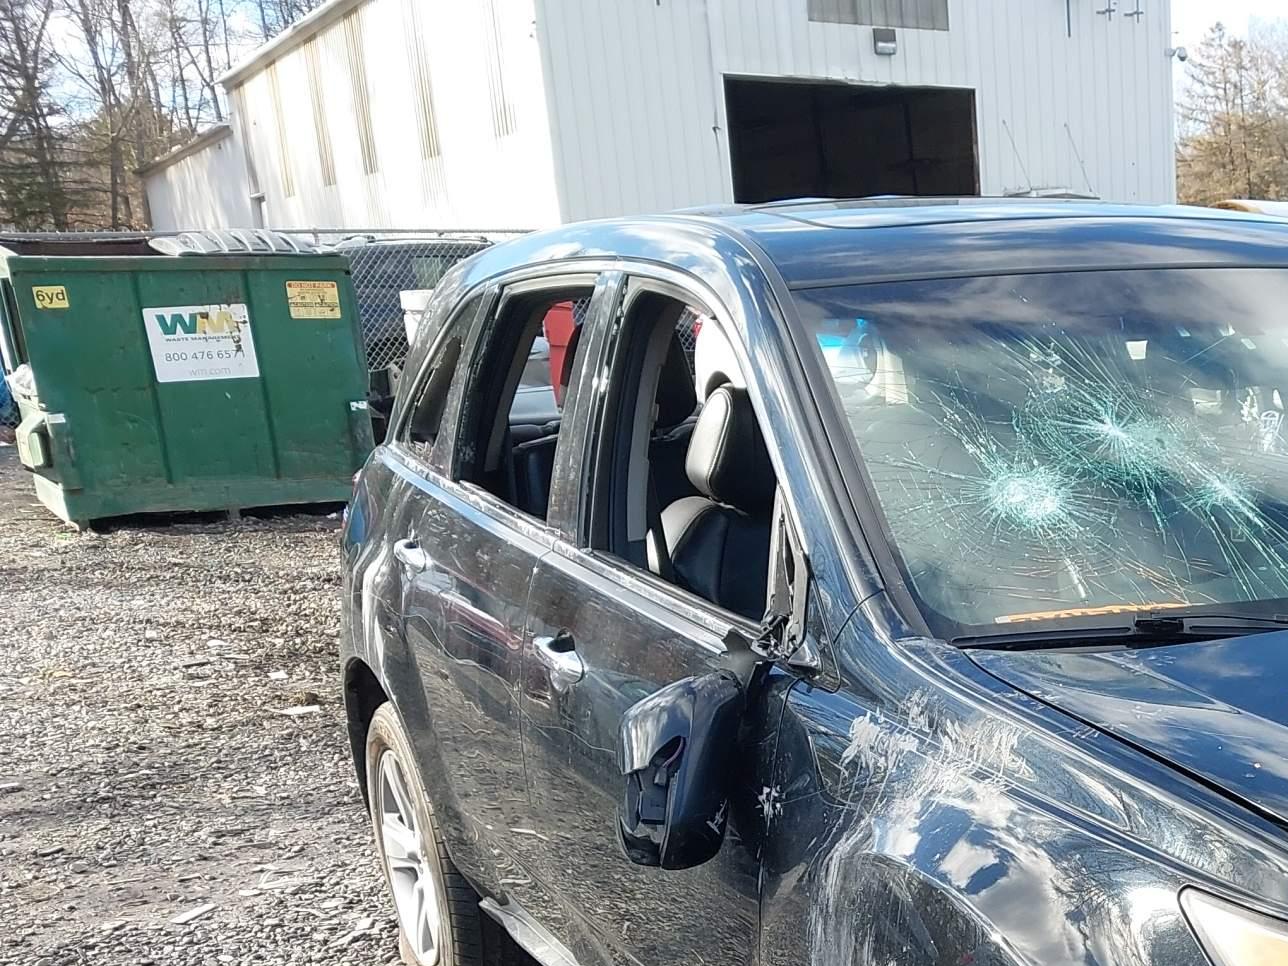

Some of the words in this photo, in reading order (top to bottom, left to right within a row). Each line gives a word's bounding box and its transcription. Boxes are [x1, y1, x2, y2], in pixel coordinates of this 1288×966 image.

[36, 289, 66, 304] 6yd
[155, 311, 235, 335] WM
[164, 352, 188, 362] 800
[191, 351, 214, 360] 476
[189, 367, 231, 376] wm.com
